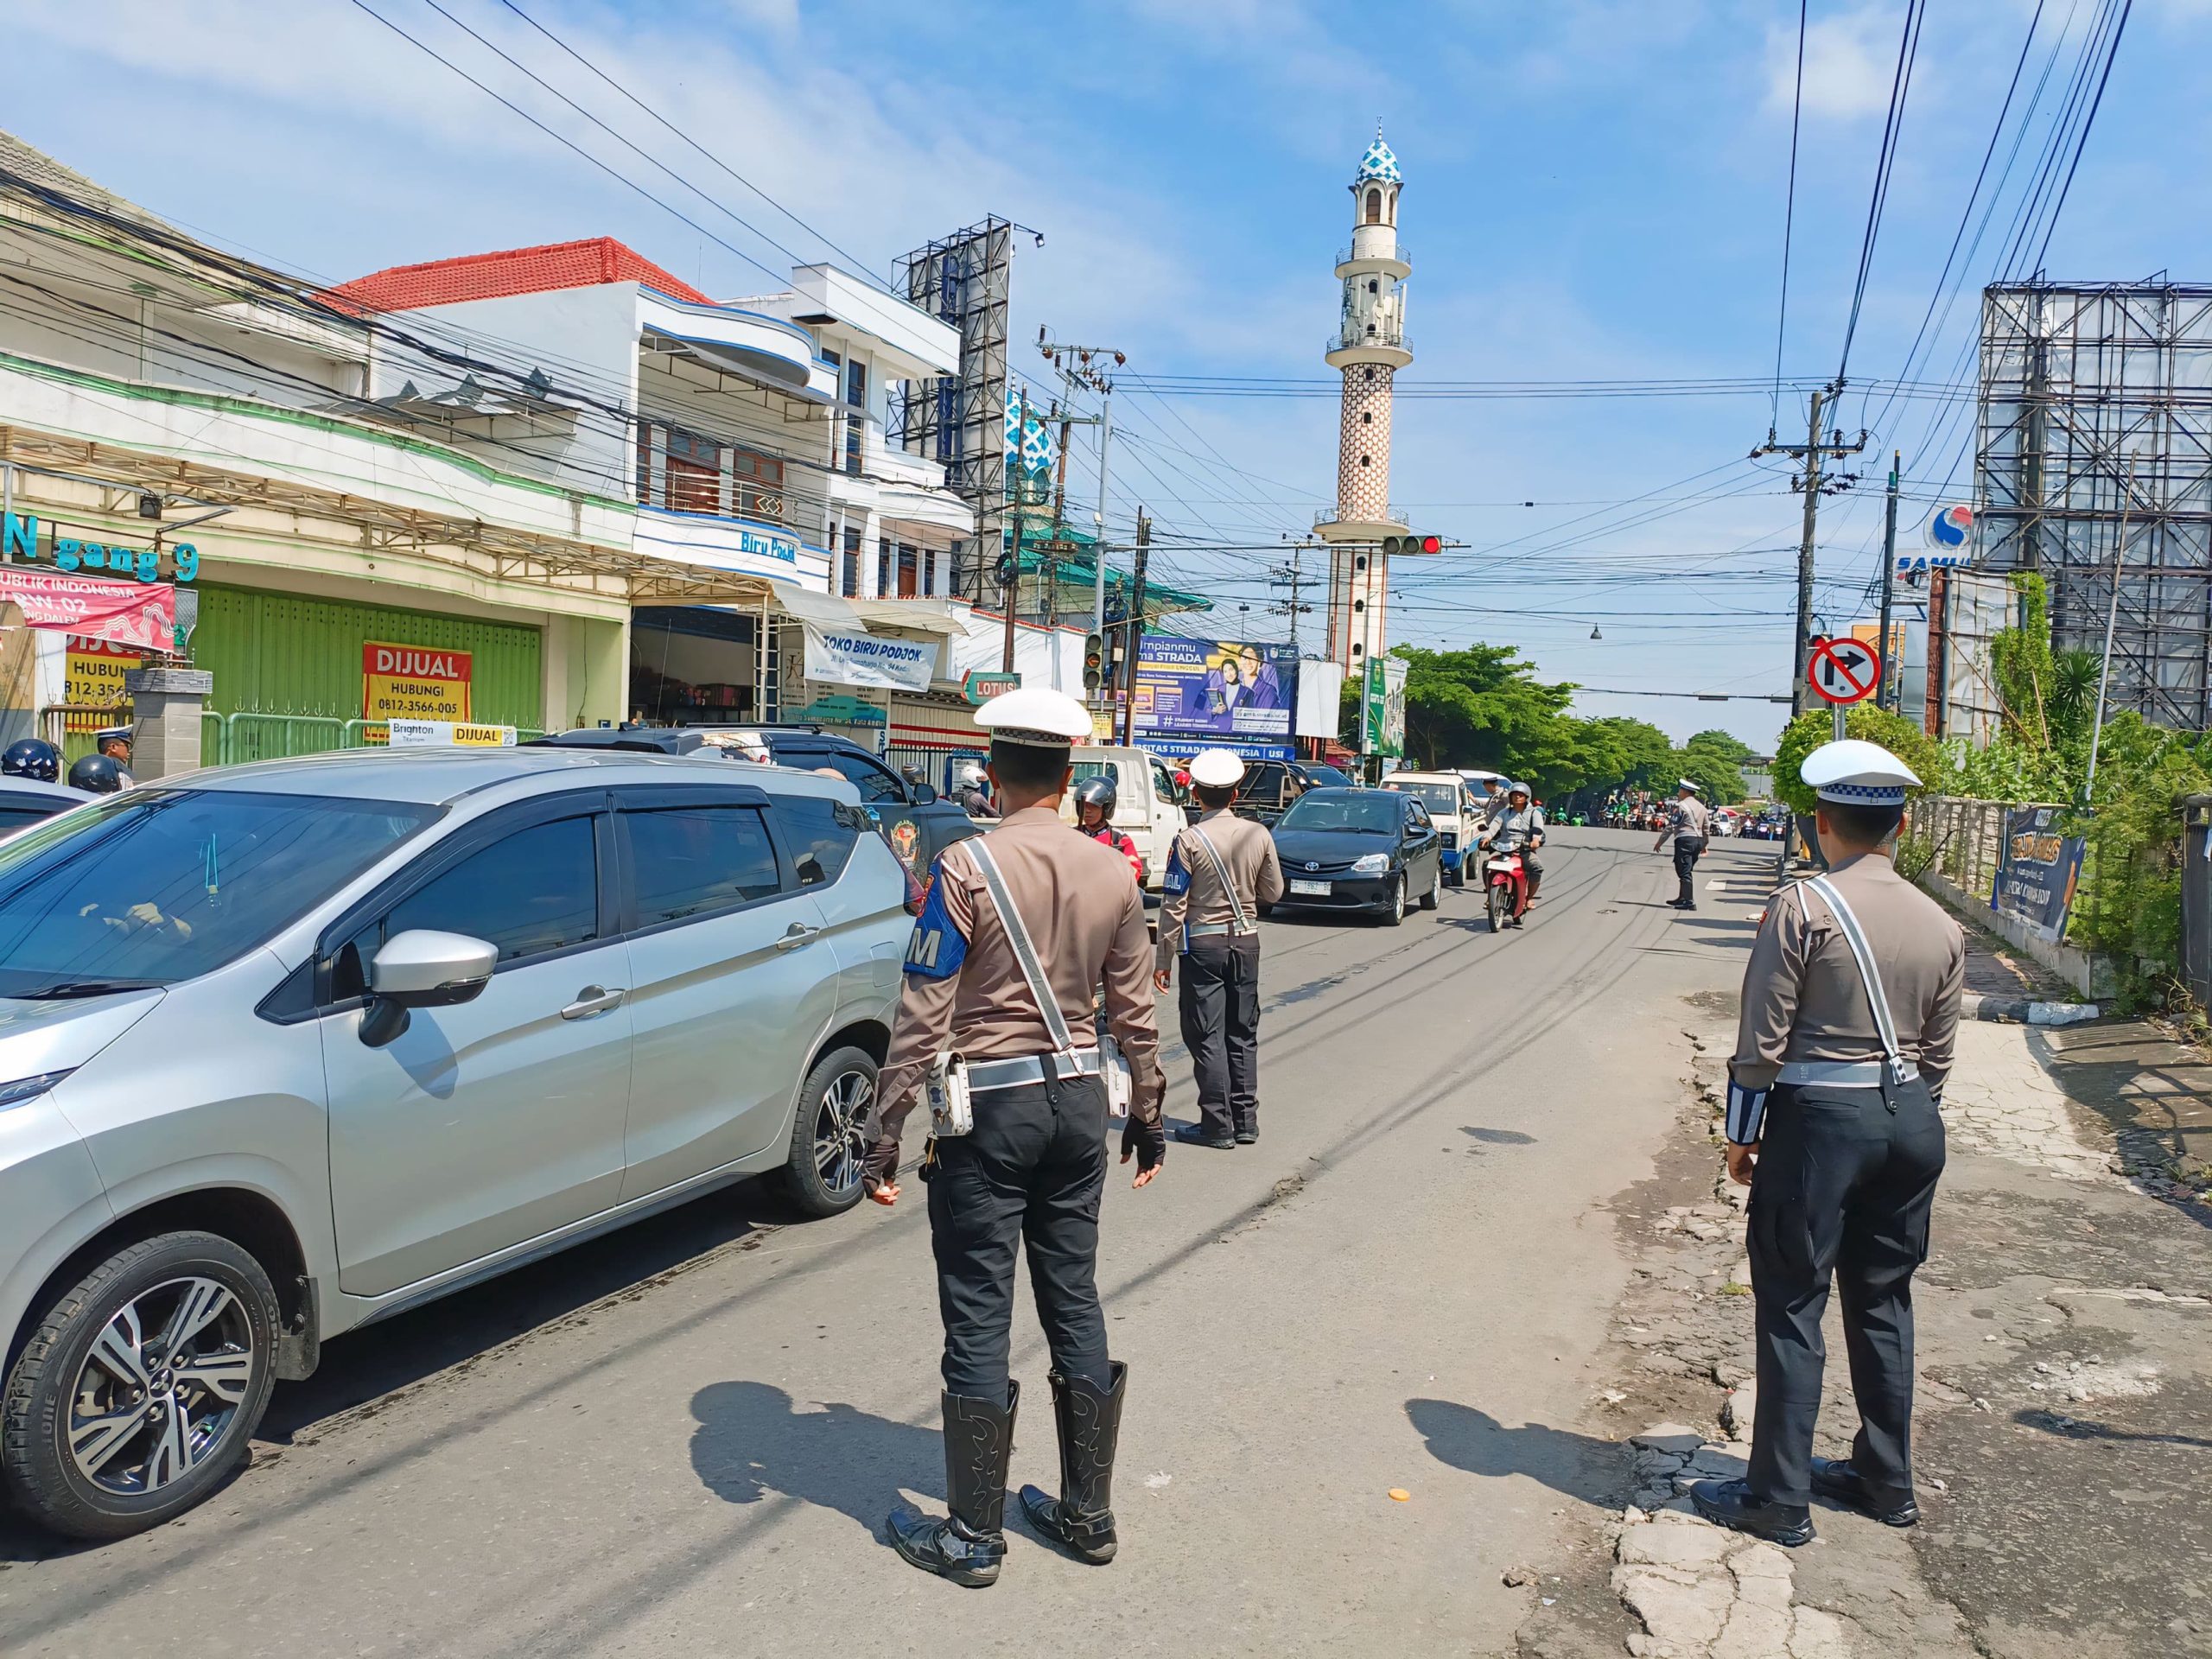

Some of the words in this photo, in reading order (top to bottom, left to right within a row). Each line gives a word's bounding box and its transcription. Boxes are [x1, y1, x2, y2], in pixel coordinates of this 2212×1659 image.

[741, 531, 767, 554] Biru
[175, 543, 199, 582] 9
[52, 580, 136, 599] INDONESIA
[823, 635, 852, 652] TOKO
[853, 640, 880, 655] BIRU
[879, 645, 922, 662] PODJOK
[377, 650, 458, 678] DIJUAL
[1156, 652, 1202, 664] STRADA
[391, 682, 444, 697] HUBUNGI
[976, 682, 1014, 696] LOTUS
[378, 698, 457, 714] 0812-3566-005
[393, 722, 434, 735] Brighton
[456, 728, 498, 741] DIJUAL
[907, 927, 942, 969] M
